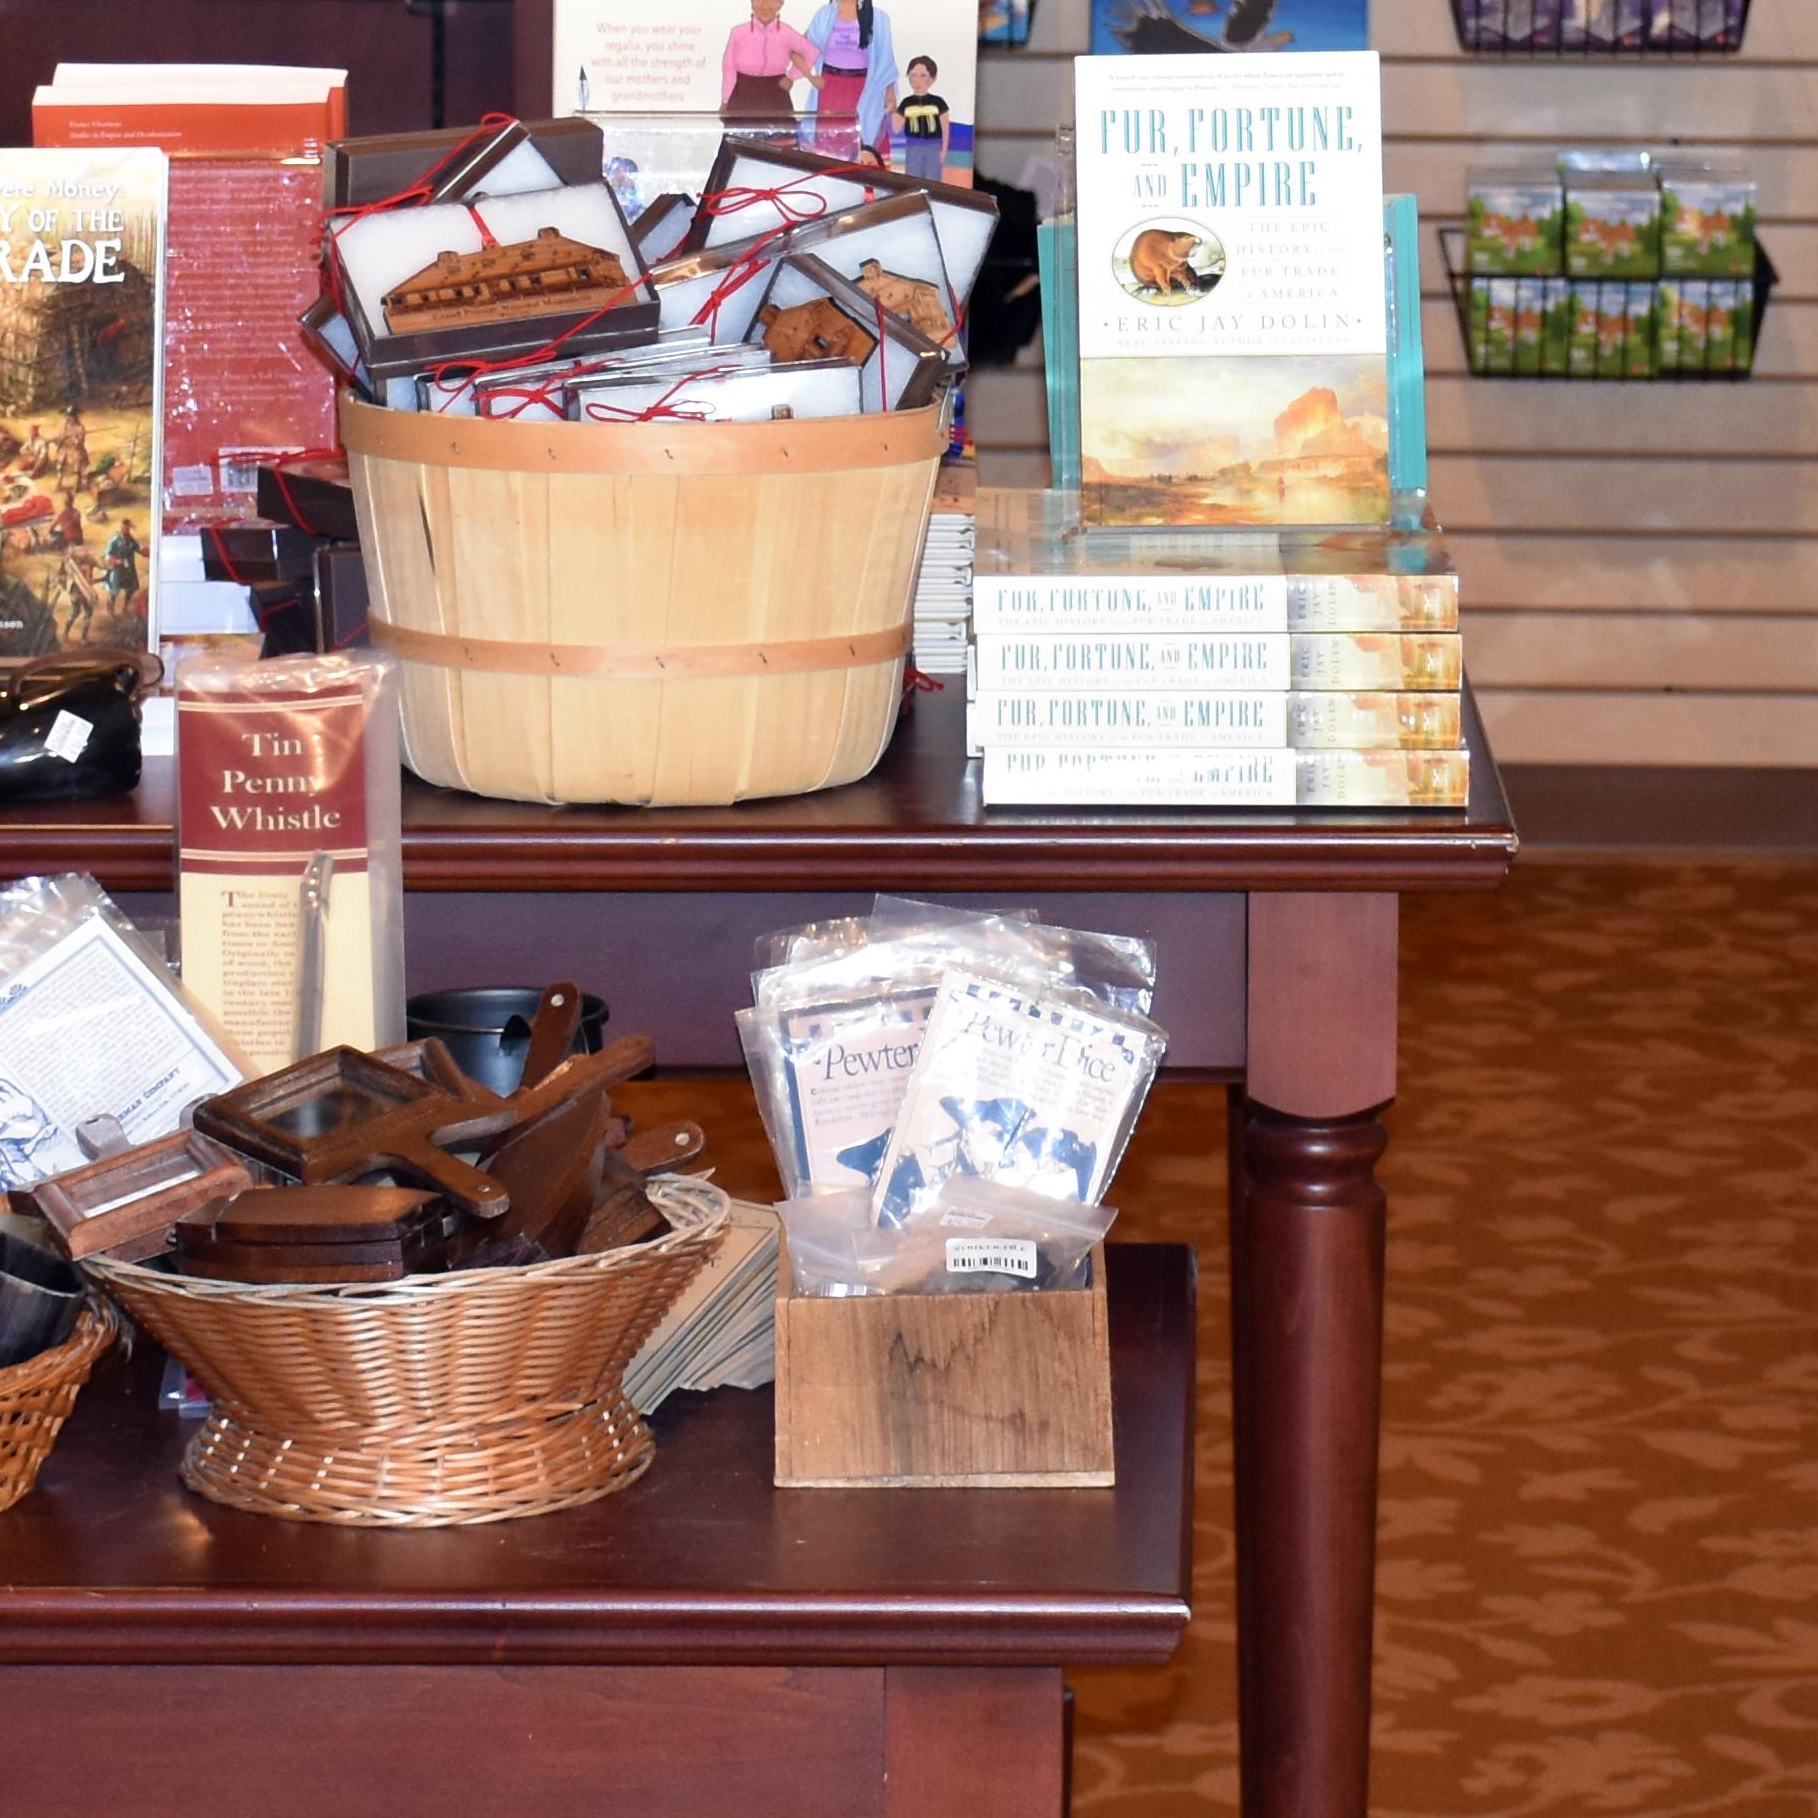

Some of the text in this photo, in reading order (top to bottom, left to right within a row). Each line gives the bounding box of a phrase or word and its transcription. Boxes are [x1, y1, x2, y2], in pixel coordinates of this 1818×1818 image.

[597, 23, 702, 37] When you wear your
[605, 39, 695, 54] regalia, you shine
[591, 56, 706, 70] with all the strength of
[606, 73, 691, 85] our mothers and
[611, 89, 684, 103] grandmothers
[1100, 106, 1363, 157] FUR, FORTUNE,
[1133, 161, 1316, 208] AND EMPIRE
[28, 209, 57, 233] OF
[71, 209, 124, 233] THE
[1248, 220, 1330, 234] THE EPIC
[1236, 244, 1311, 255] HISTORY
[1241, 264, 1340, 278] FUR TRADE
[1262, 287, 1339, 299] AMERICA
[1118, 314, 1350, 334] ERIC JAY DOLIN
[998, 583, 1263, 613] FUR, FORTUNE, AND EMPIRE
[1002, 643, 1267, 672] FUR, FORTUNE, AND EMPIRE
[998, 699, 1263, 728] FUR, FORTUNE, AND EMPIRE
[241, 732, 302, 757] Tin
[223, 769, 320, 797] Penny
[210, 804, 341, 831] Whistle
[824, 1042, 919, 1080] Pewter
